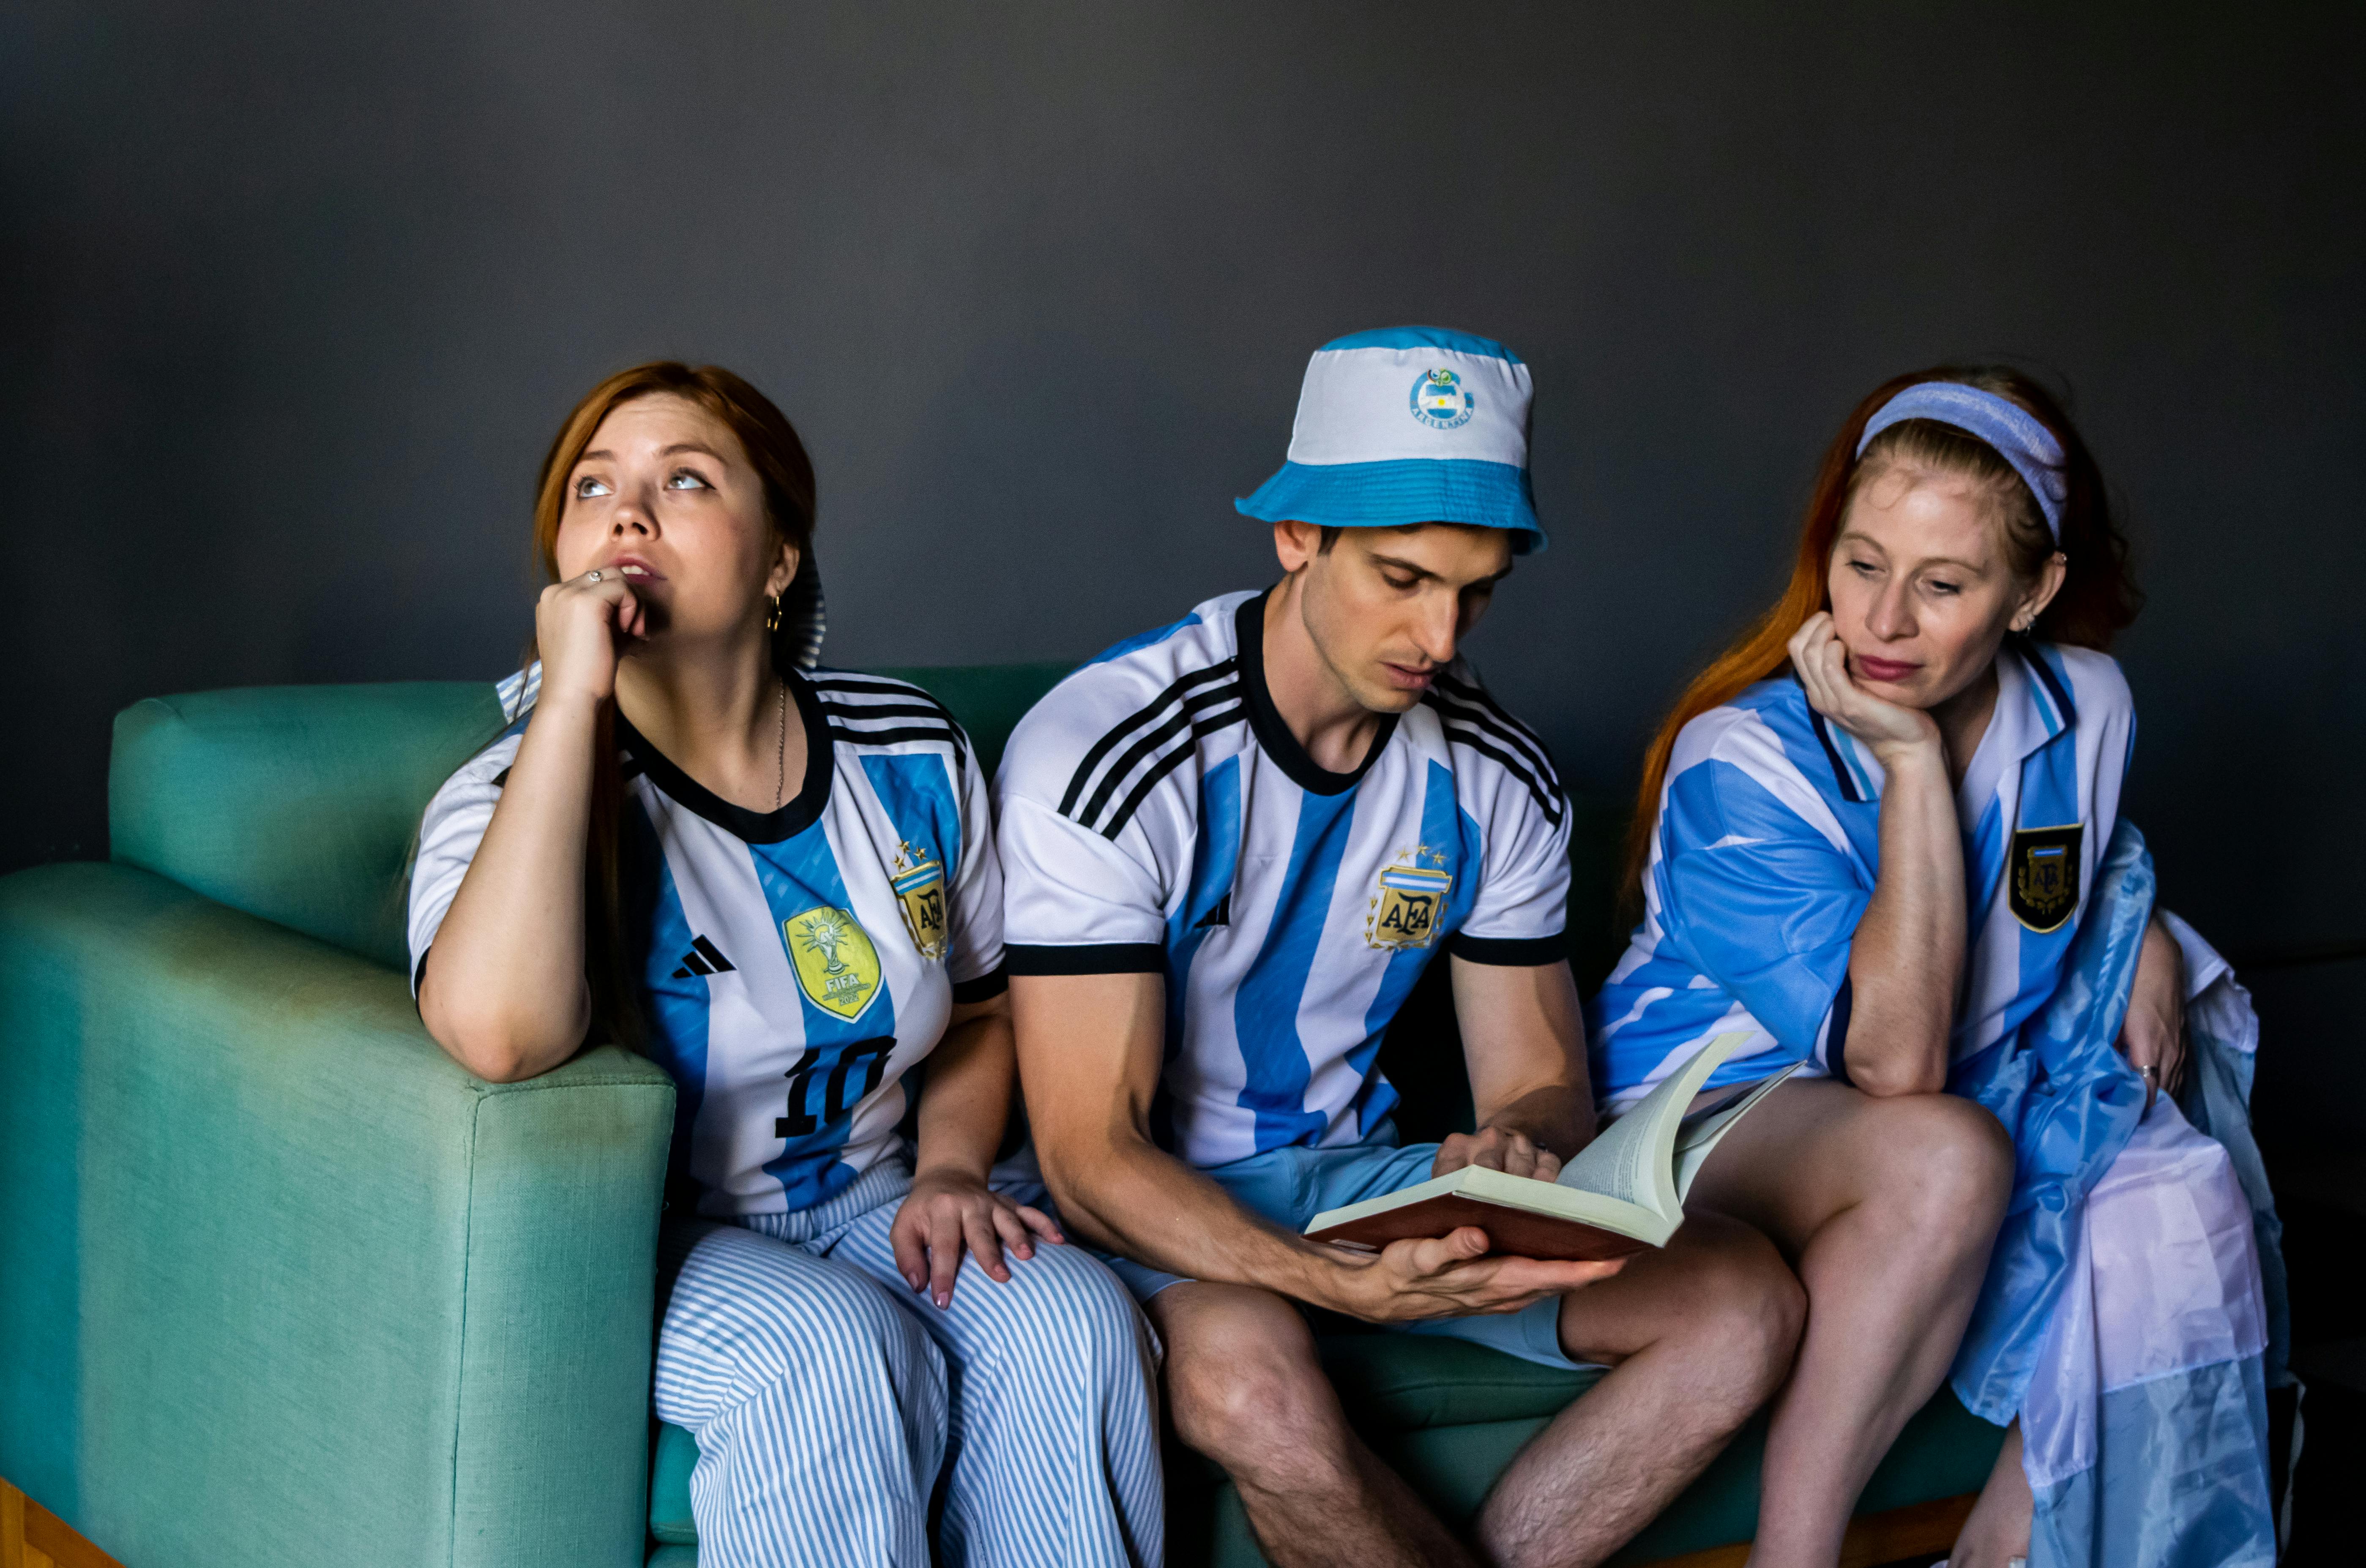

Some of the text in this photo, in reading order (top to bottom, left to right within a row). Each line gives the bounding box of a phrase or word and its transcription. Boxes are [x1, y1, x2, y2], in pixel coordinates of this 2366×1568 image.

[1381, 892, 1432, 935] AFA
[826, 974, 860, 992] FIFA
[839, 993, 859, 1005] 2022
[775, 1035, 897, 1138] 10
